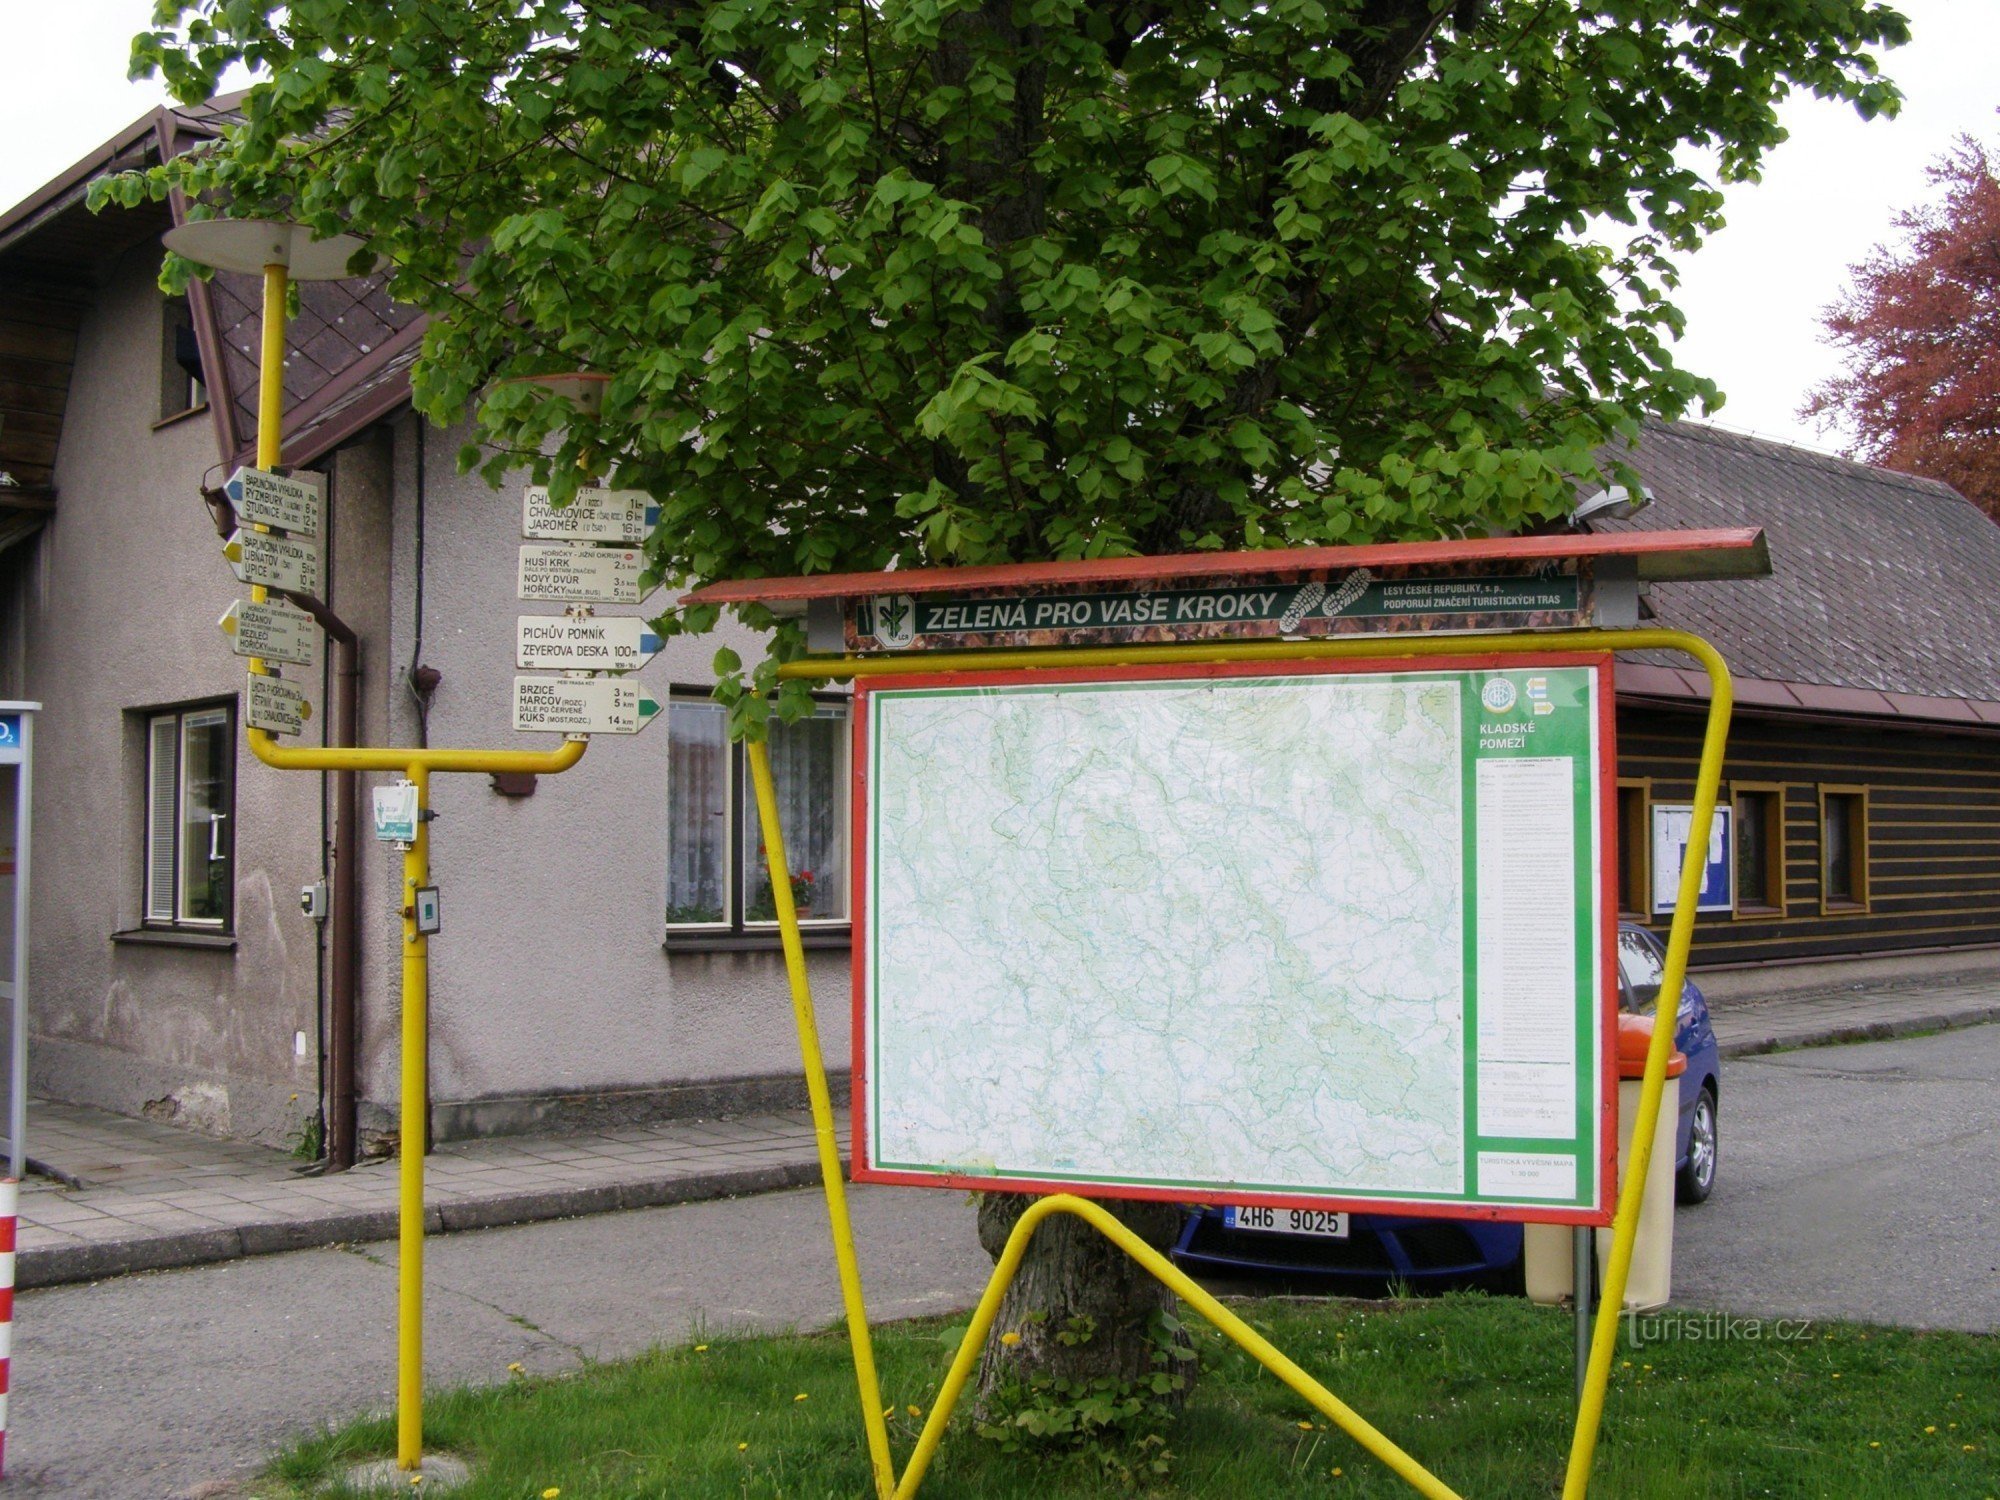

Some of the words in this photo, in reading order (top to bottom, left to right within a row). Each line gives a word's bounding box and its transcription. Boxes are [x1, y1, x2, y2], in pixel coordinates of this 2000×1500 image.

[246, 501, 280, 518] STUDNICE
[529, 507, 596, 520] CHVALKOVICE
[303, 515, 311, 526] 12
[625, 510, 634, 521] 6
[528, 519, 579, 532] JAROMĚŘ
[622, 523, 633, 533] 16
[549, 559, 570, 567] KRK
[524, 573, 551, 583] NOVÝ
[553, 574, 579, 584] DVŮR
[523, 583, 566, 594] HOŘIČKY
[1384, 586, 1403, 596] LESY
[1405, 583, 1433, 595] ČESKÉ
[1383, 597, 1432, 609] PODPORUJÍ
[1433, 595, 1471, 608] ZNAČENÍ
[1472, 594, 1536, 607] TURISTICKÝCH
[1537, 594, 1561, 605] TRAS
[926, 600, 1027, 630] ZELENÁ
[1034, 601, 1092, 626] PRO
[1099, 592, 1169, 623] VAŠE
[1175, 592, 1278, 620] KROKY
[523, 624, 564, 639] PICHŮV
[567, 625, 606, 640] POMNÍK
[522, 645, 574, 657] ZEYEROVA
[577, 645, 609, 657] DESKA
[520, 685, 555, 695] BRZICE
[614, 688, 620, 697] 3
[520, 696, 561, 706] HARCOV
[614, 699, 620, 707] 5
[519, 713, 545, 723] KUKS
[608, 716, 620, 724] 14
[1480, 720, 1536, 734] KLADSKÉ
[1479, 736, 1526, 749] POMEZÍ
[1240, 1206, 1275, 1228] 4H6
[1289, 1208, 1339, 1233] 9025
